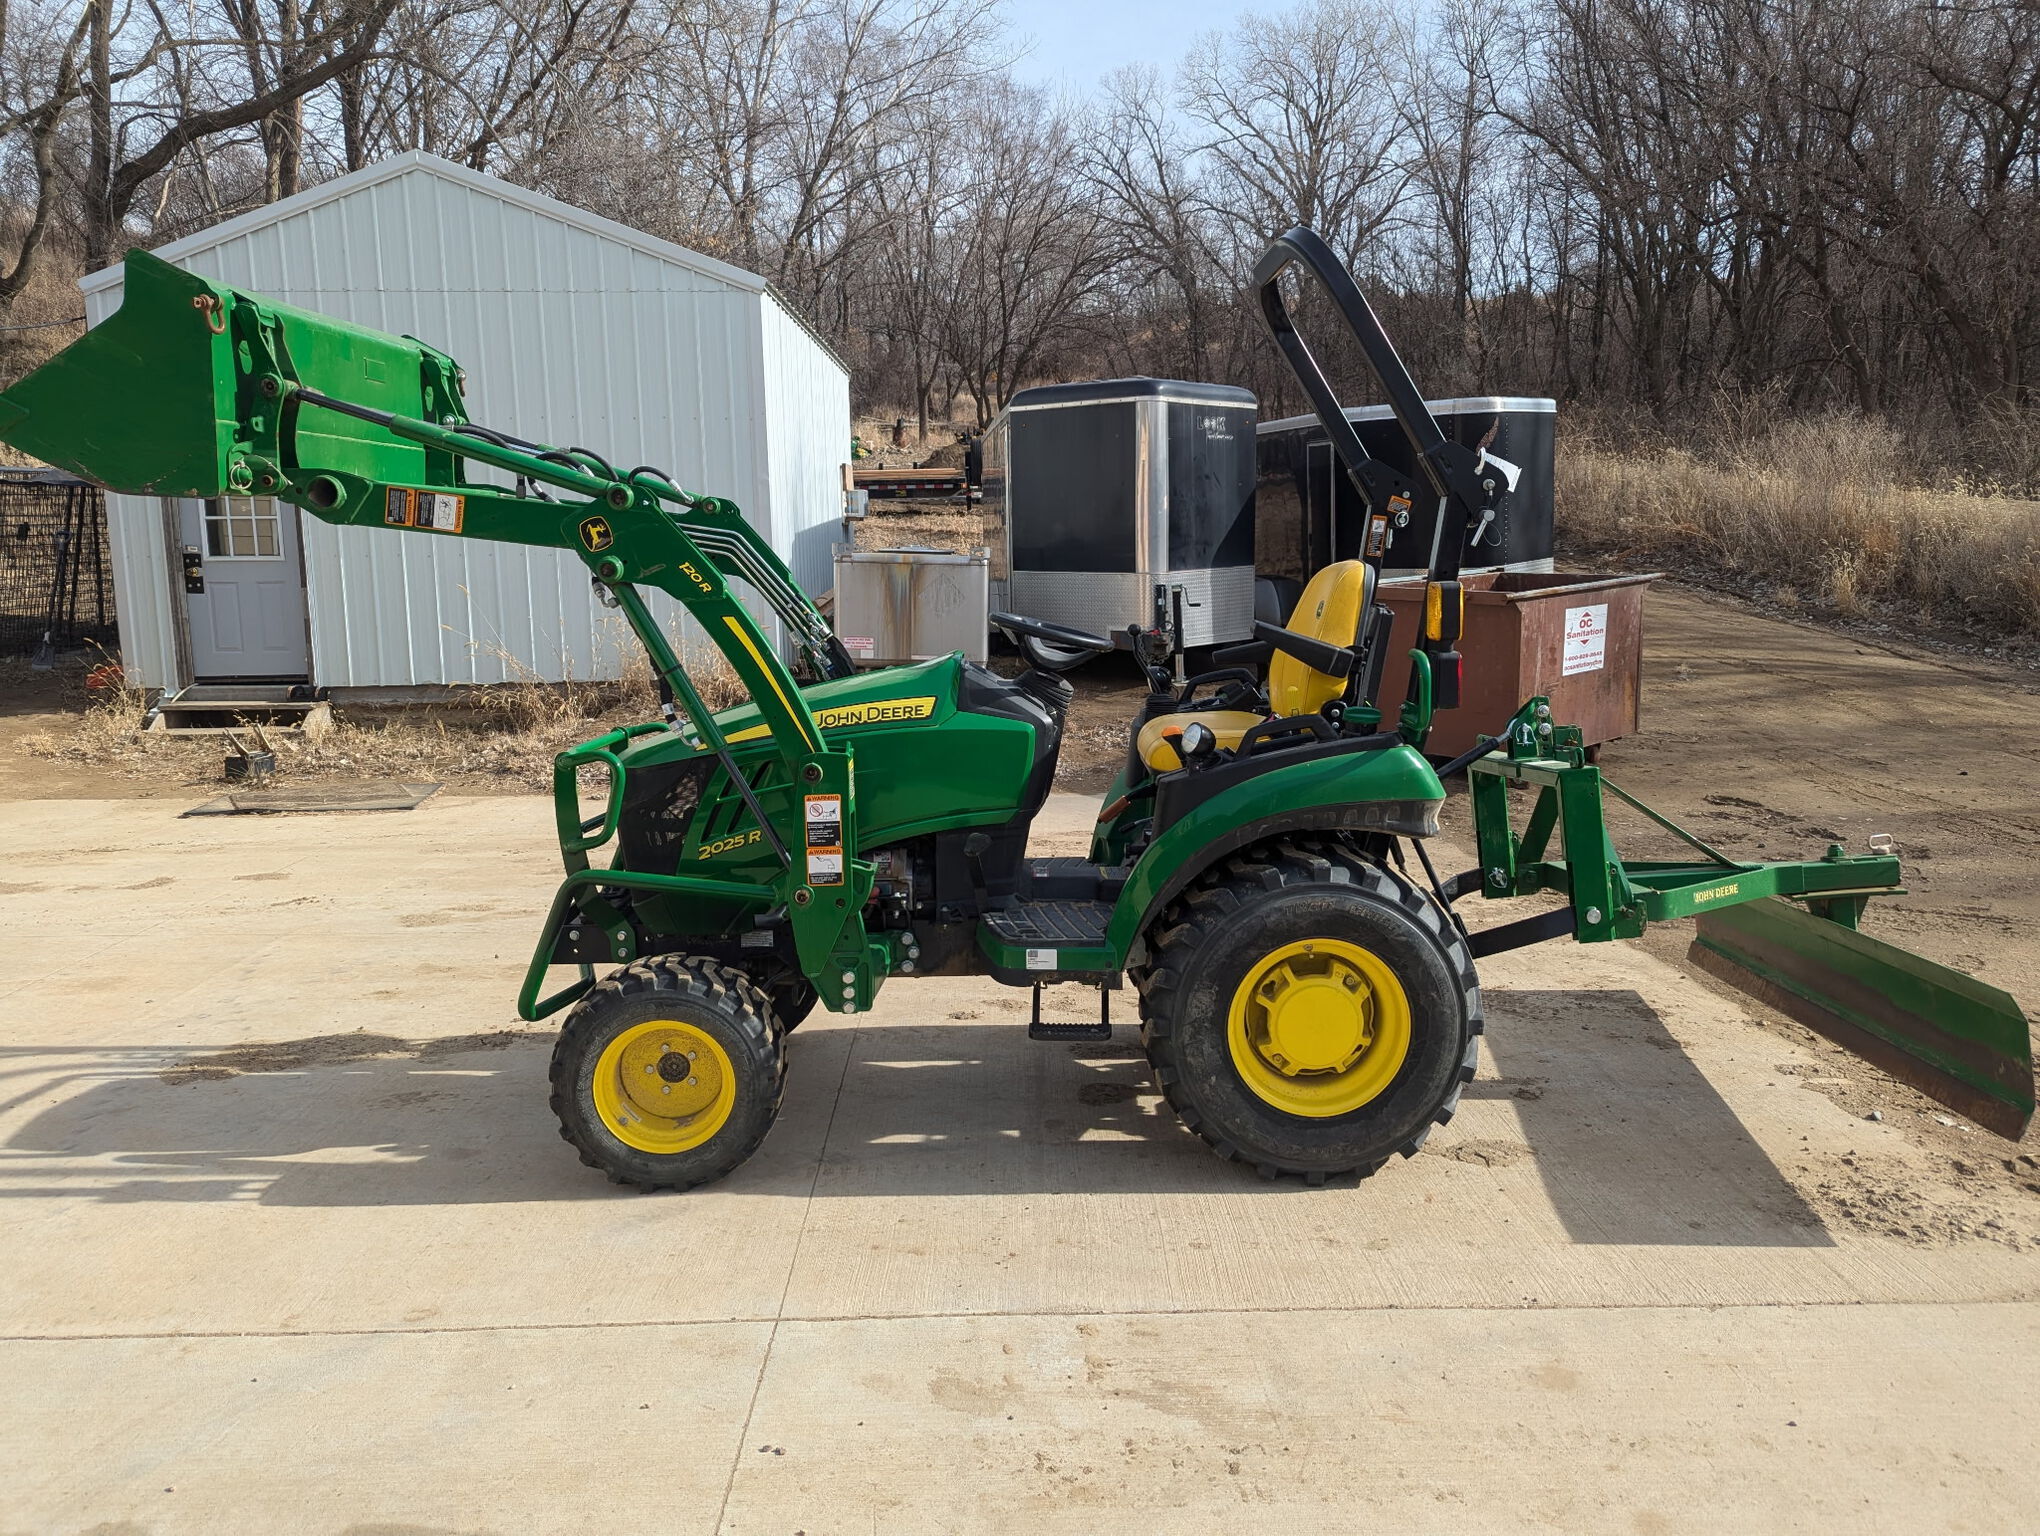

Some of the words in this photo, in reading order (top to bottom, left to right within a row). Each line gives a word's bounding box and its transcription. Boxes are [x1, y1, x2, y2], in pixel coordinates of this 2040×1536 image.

[1579, 618, 1593, 629] OC
[1566, 628, 1604, 640] Sanitation
[819, 710, 862, 727] JOHN
[867, 705, 925, 721] DEERE
[698, 834, 745, 861] 2025
[748, 830, 761, 844] R
[1694, 890, 1714, 903] JOHN
[1715, 884, 1739, 898] DEERE
